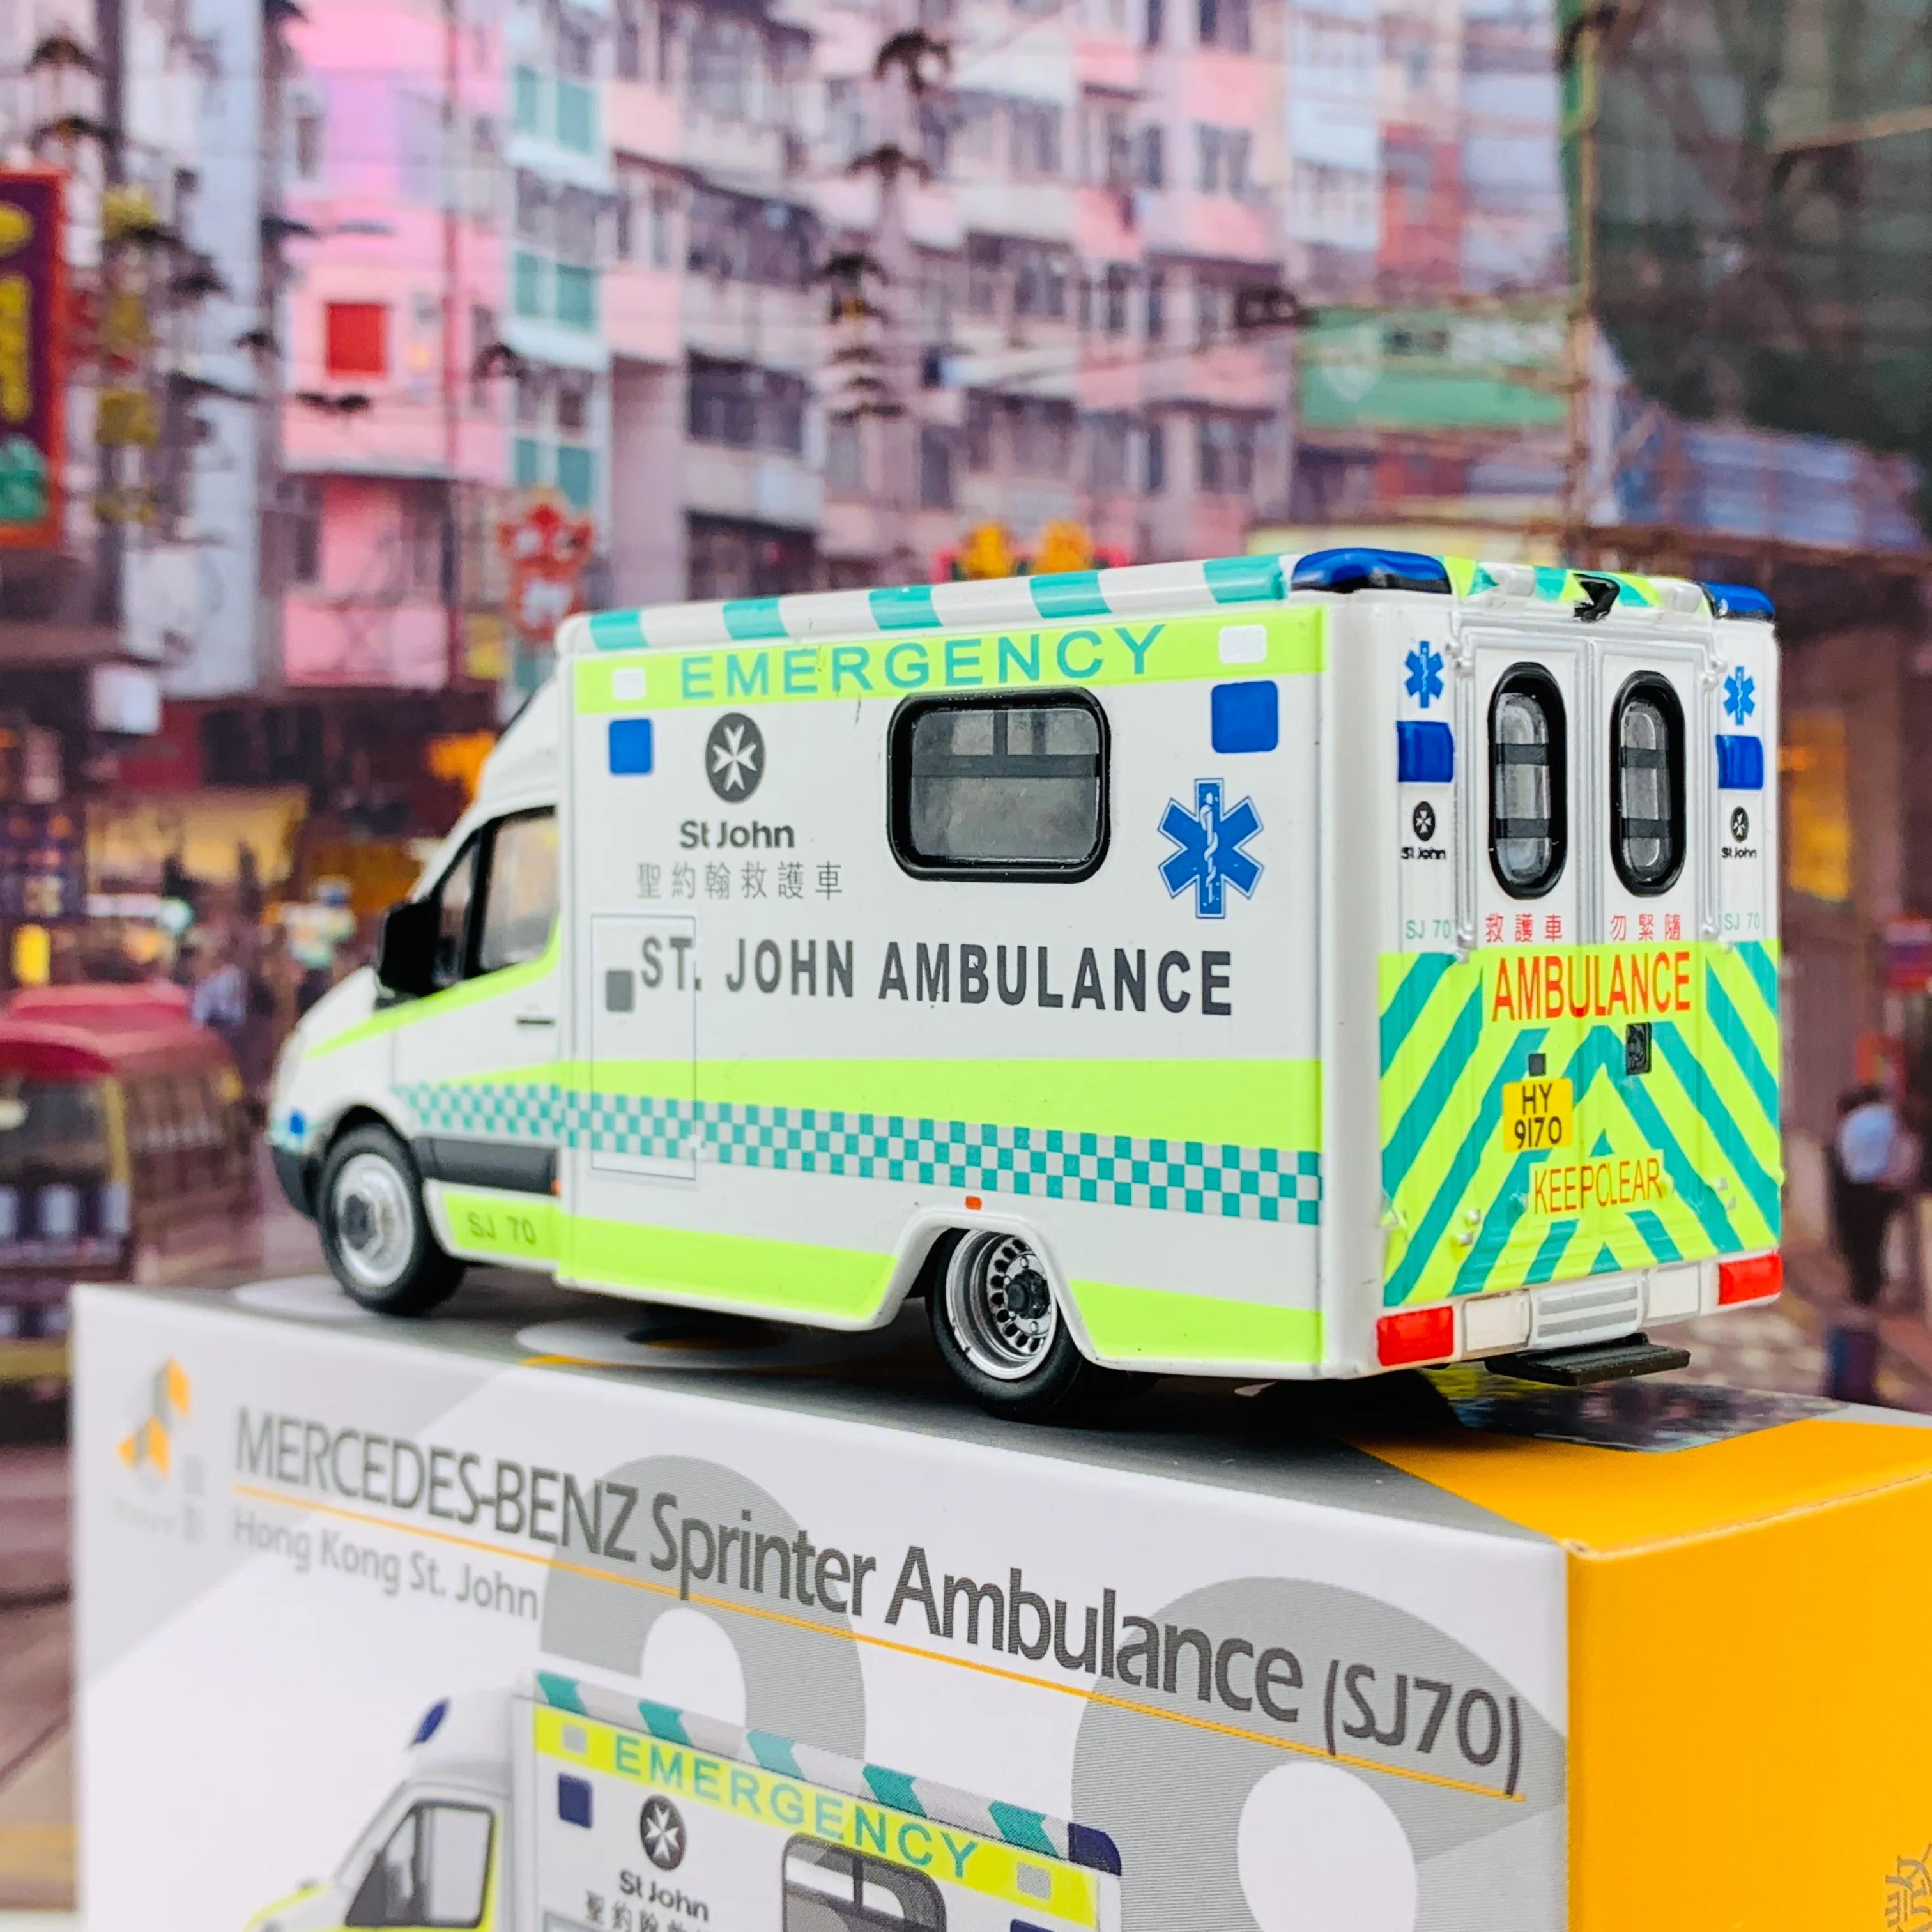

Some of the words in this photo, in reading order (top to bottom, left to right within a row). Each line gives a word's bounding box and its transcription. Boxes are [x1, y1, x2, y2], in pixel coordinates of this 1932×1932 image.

[680, 624, 1165, 700] EMERGENCY
[679, 820, 710, 849] St
[717, 820, 795, 848] John
[637, 861, 843, 901] 聖約翰救護車
[1406, 919, 1425, 939] SJ
[1432, 919, 1450, 939] 70
[1485, 912, 1562, 943] 救護車
[1610, 913, 1682, 942] 勿緊隨
[1725, 913, 1740, 930] SJ
[1747, 912, 1761, 930] 70
[641, 936, 702, 992] ST.
[726, 938, 853, 998] JOHN
[878, 941, 1232, 1016] AMBULANCE
[1492, 951, 1690, 1022] AMBULANCE
[1522, 1082, 1553, 1116] HY
[1514, 1116, 1563, 1149] 9170
[466, 1211, 497, 1239] SJ
[508, 1216, 535, 1246] 70
[234, 1504, 310, 1572] Hong
[321, 1531, 399, 1597] Kong
[410, 1551, 447, 1597] St.
[456, 1563, 538, 1620] John
[234, 1406, 638, 1563] MERCEDES-BENZ
[650, 1492, 876, 1617] Sprinter
[885, 1545, 1304, 1722] Ambulance
[1323, 1659, 1522, 1796] (SJ70)
[615, 1733, 978, 1878] EMERGENCY
[619, 1869, 643, 1898] St
[648, 1880, 709, 1922] John
